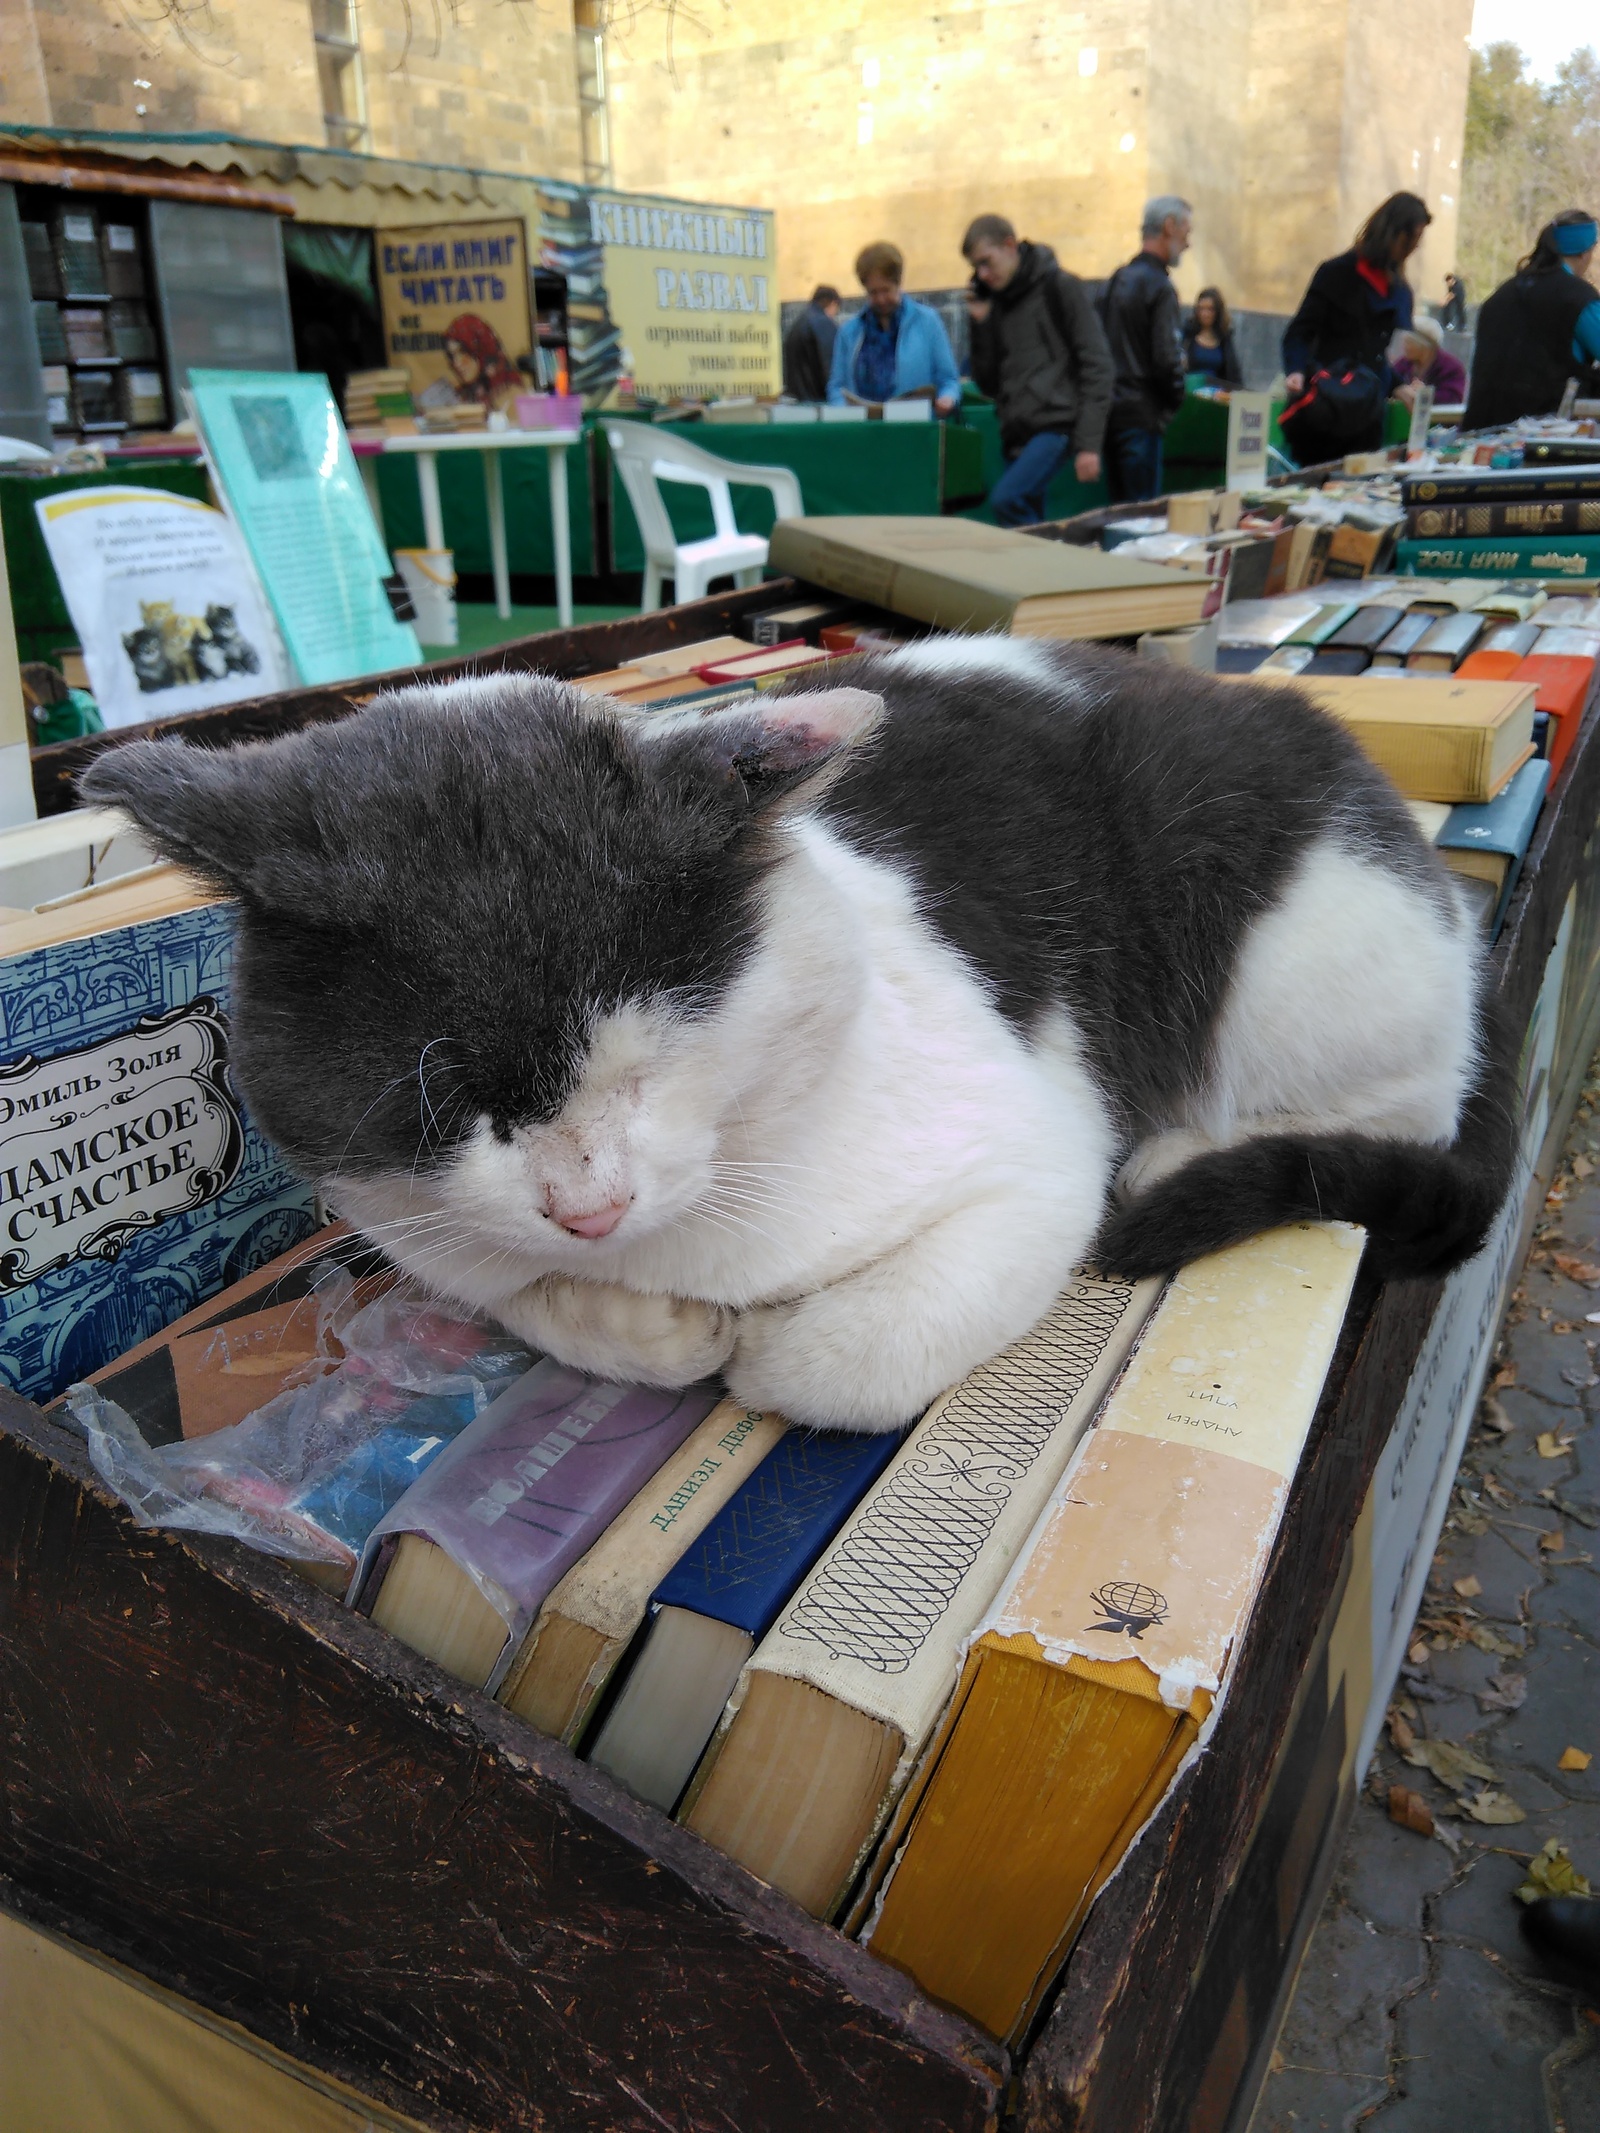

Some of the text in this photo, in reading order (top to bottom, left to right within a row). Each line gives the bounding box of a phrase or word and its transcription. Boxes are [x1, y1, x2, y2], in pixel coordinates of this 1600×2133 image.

[588, 199, 767, 258] КНИЖНЫЙ
[383, 235, 517, 274] ЕСЛИ КНИГ
[401, 273, 506, 305] ЧИТАТЬ
[654, 267, 770, 314] РАЗВАЛ
[1469, 552, 1520, 570] ИМЯ
[0, 1044, 182, 1125] Эмиль Золя
[0, 1096, 199, 1204] ДАМСКОЕ
[8, 1139, 196, 1243] СЧАСТЬЕ
[1186, 1390, 1239, 1410] УПИТ
[1166, 1412, 1243, 1437] АНДРЕЙ
[405, 1435, 443, 1464] 1
[649, 1457, 723, 1533] ДАНИЭЛ
